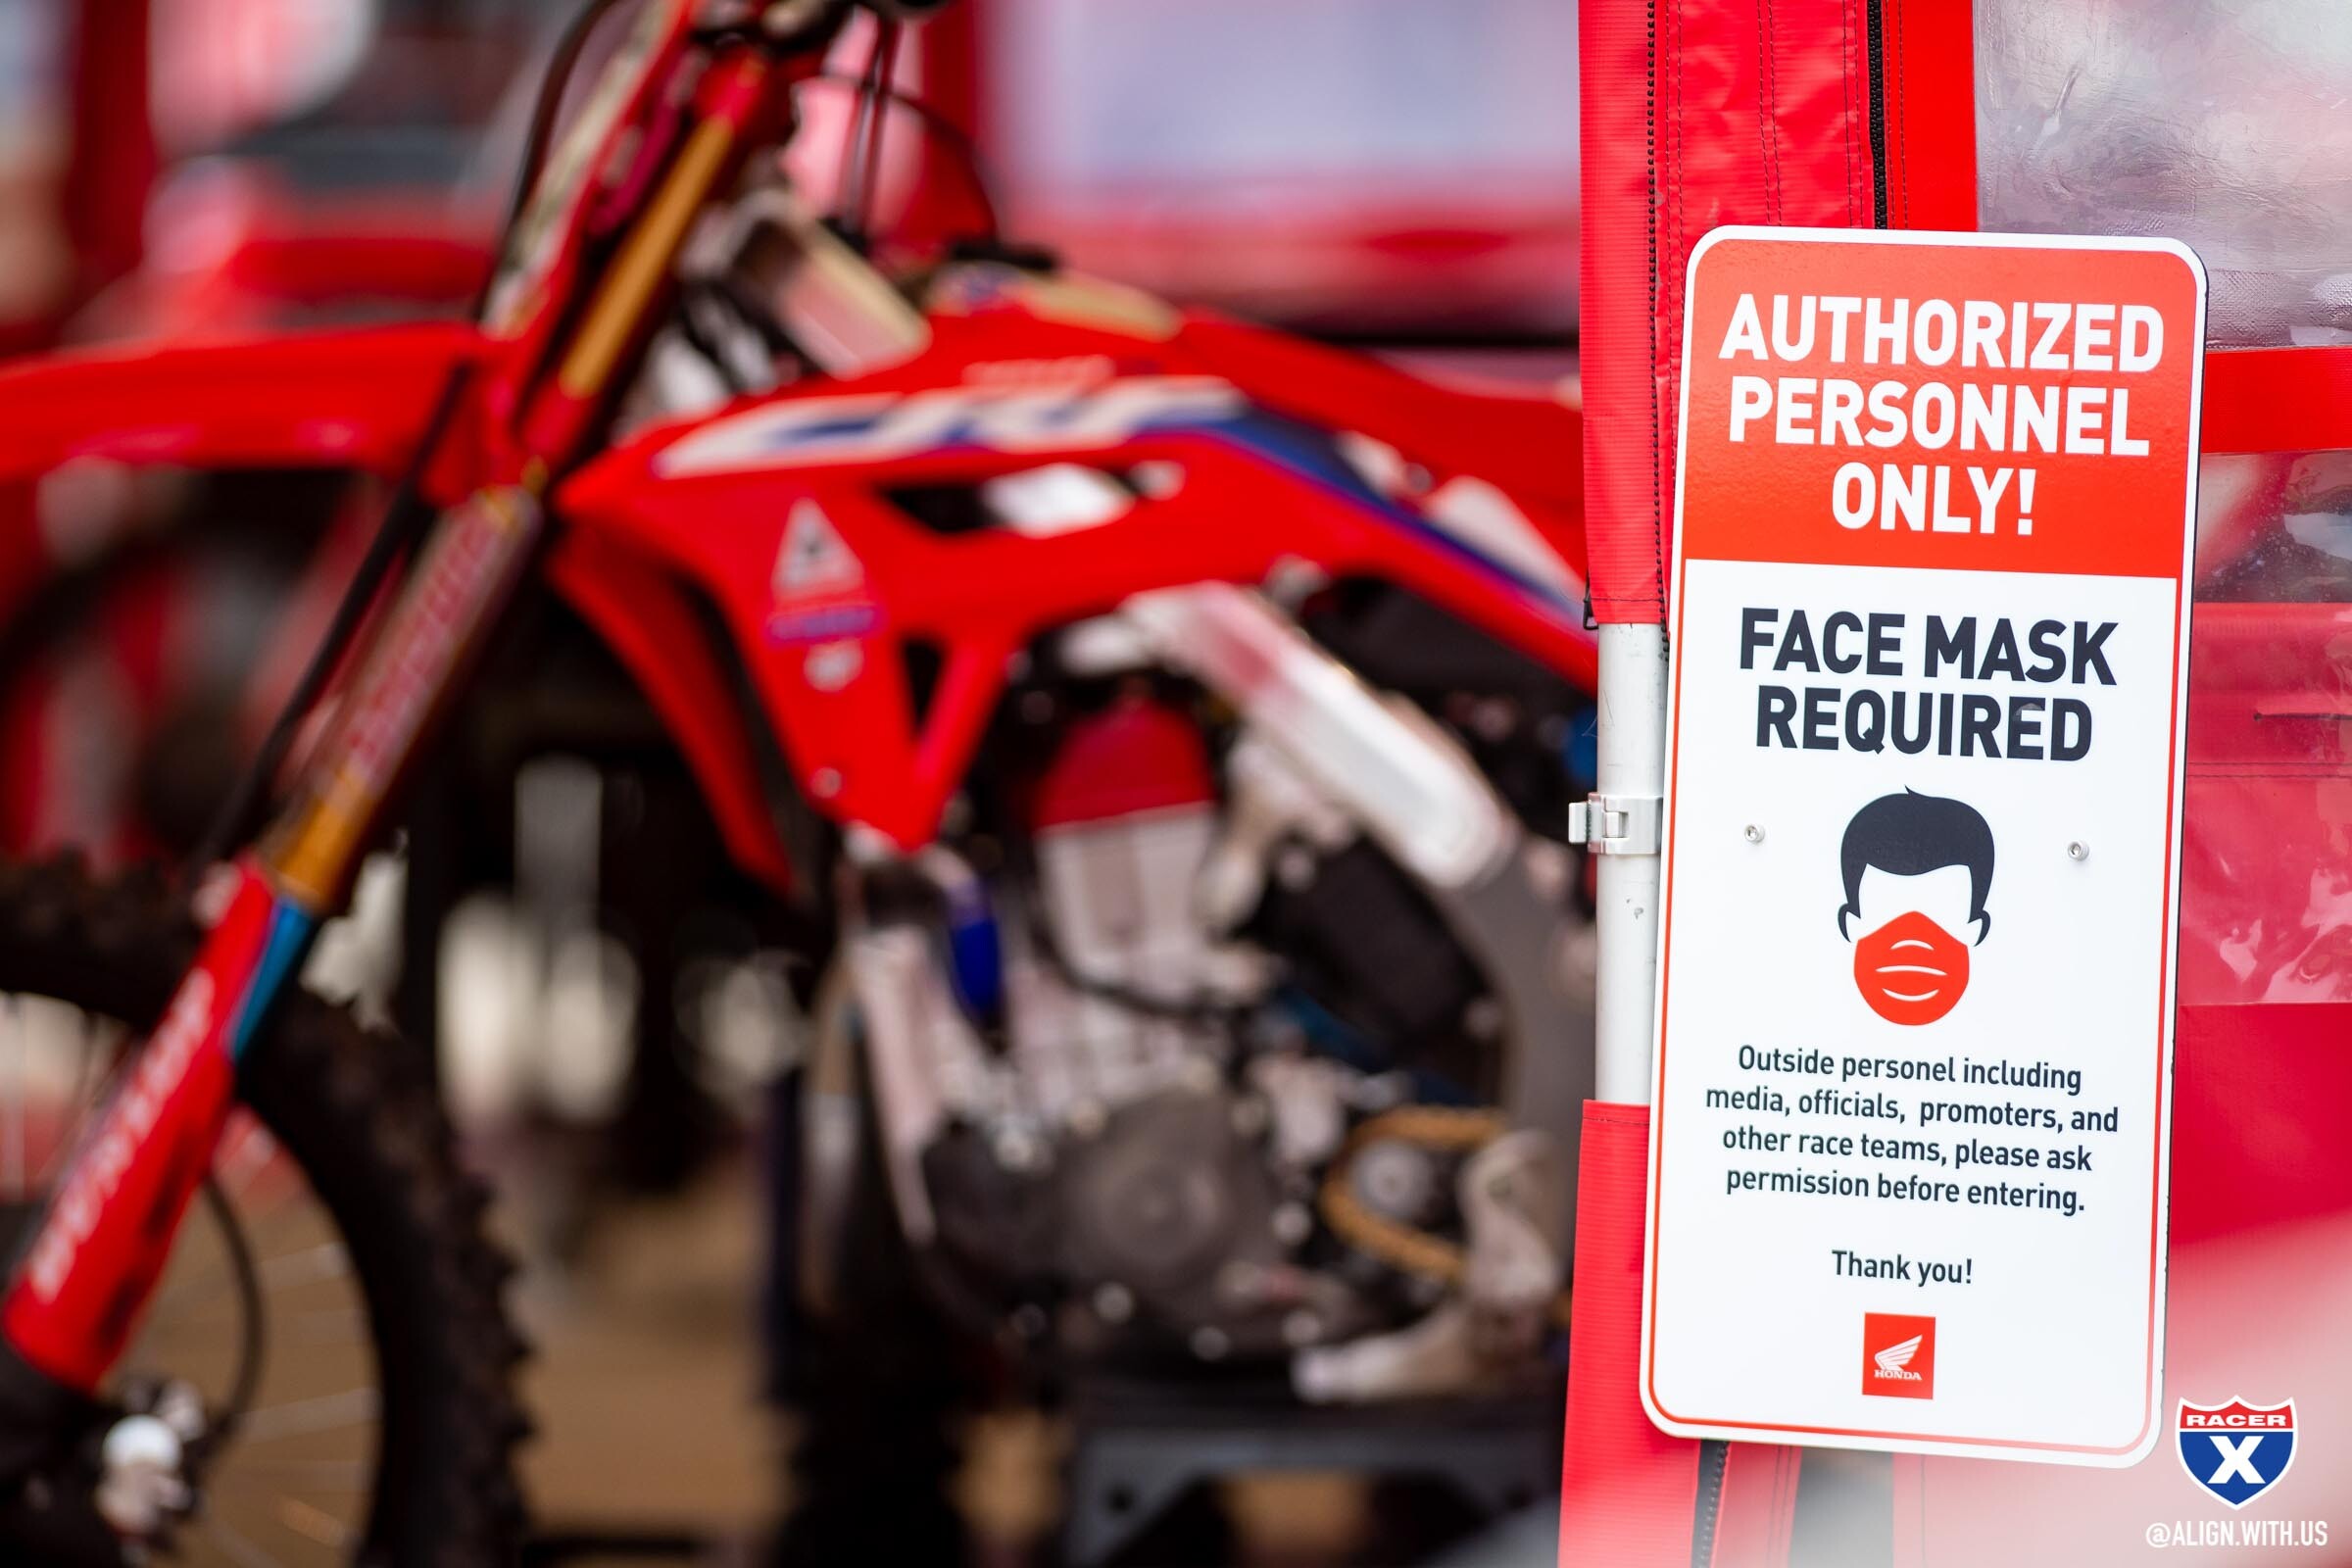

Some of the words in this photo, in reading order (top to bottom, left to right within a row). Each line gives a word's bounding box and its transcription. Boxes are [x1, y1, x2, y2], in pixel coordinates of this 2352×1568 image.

[1719, 293, 2165, 372] AUTHORIZED
[1729, 375, 2150, 456] PERSONNEL
[1832, 462, 2037, 535] ONLY!
[1740, 607, 1906, 676] FACE
[1924, 614, 2120, 686] MASK
[1755, 684, 2093, 762] REQUIRED
[1739, 1045, 1835, 1075] Outside
[1842, 1056, 1956, 1082] personel
[1963, 1057, 2082, 1096] including
[1706, 1085, 1790, 1117] media,
[1798, 1089, 1906, 1124] officials,
[1920, 1101, 2063, 1134] promoters,
[2071, 1106, 2119, 1132] and
[1723, 1125, 1791, 1152] other
[1798, 1133, 1853, 1155] race
[1861, 1133, 1947, 1167] teams,
[1955, 1139, 2039, 1169] please
[2046, 1145, 2092, 1171] ask
[1727, 1167, 1870, 1197] permission
[1878, 1173, 1960, 1202] before
[1967, 1182, 2084, 1217] entering.
[1832, 1250, 1911, 1280] Thank
[1918, 1258, 1972, 1288] you!
[1874, 1369, 1923, 1380] HONDA
